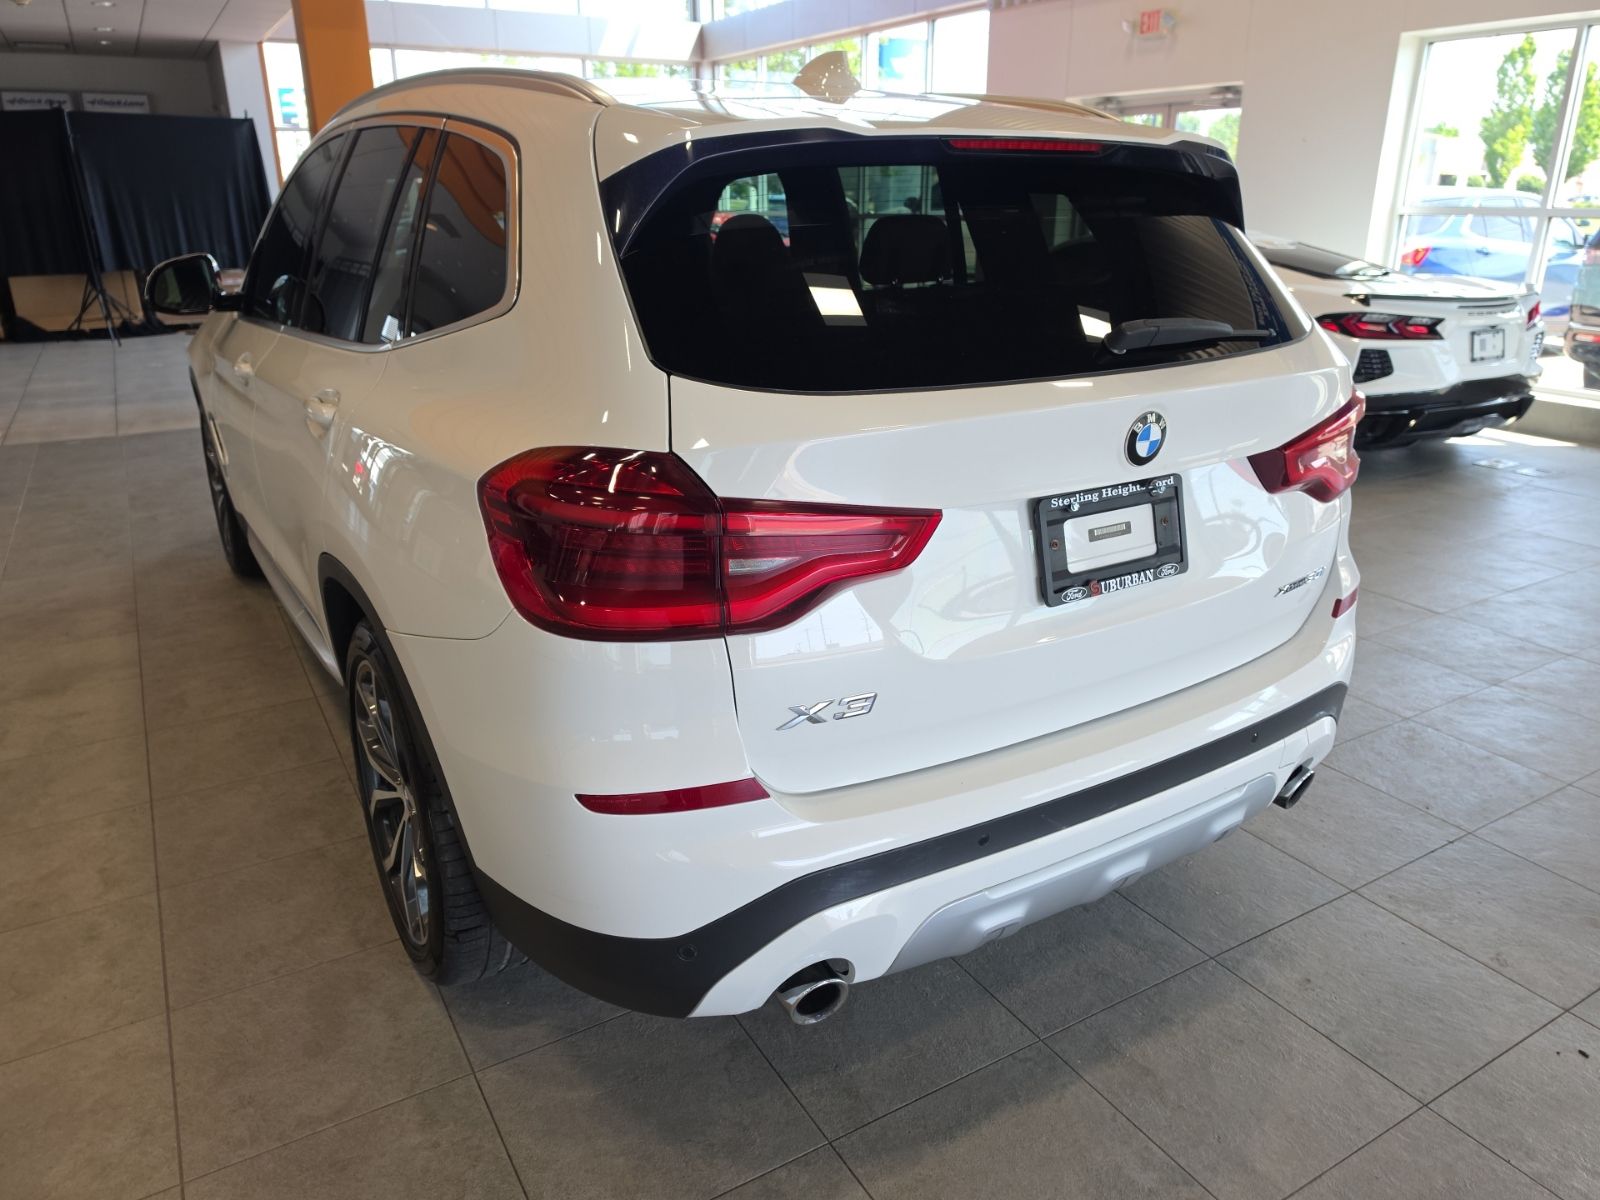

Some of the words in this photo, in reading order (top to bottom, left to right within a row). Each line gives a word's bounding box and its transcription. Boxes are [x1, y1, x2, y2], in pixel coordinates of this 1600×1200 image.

[1140, 9, 1162, 35] EXIT
[1133, 412, 1166, 433] BMW
[1050, 491, 1099, 508] Sterling
[1101, 484, 1146, 499] Height
[1148, 475, 1175, 490] ord
[1064, 588, 1085, 601] Ford
[1089, 569, 1155, 597] SUBURBAN
[1159, 564, 1177, 577] Ford
[775, 692, 878, 730] X3
